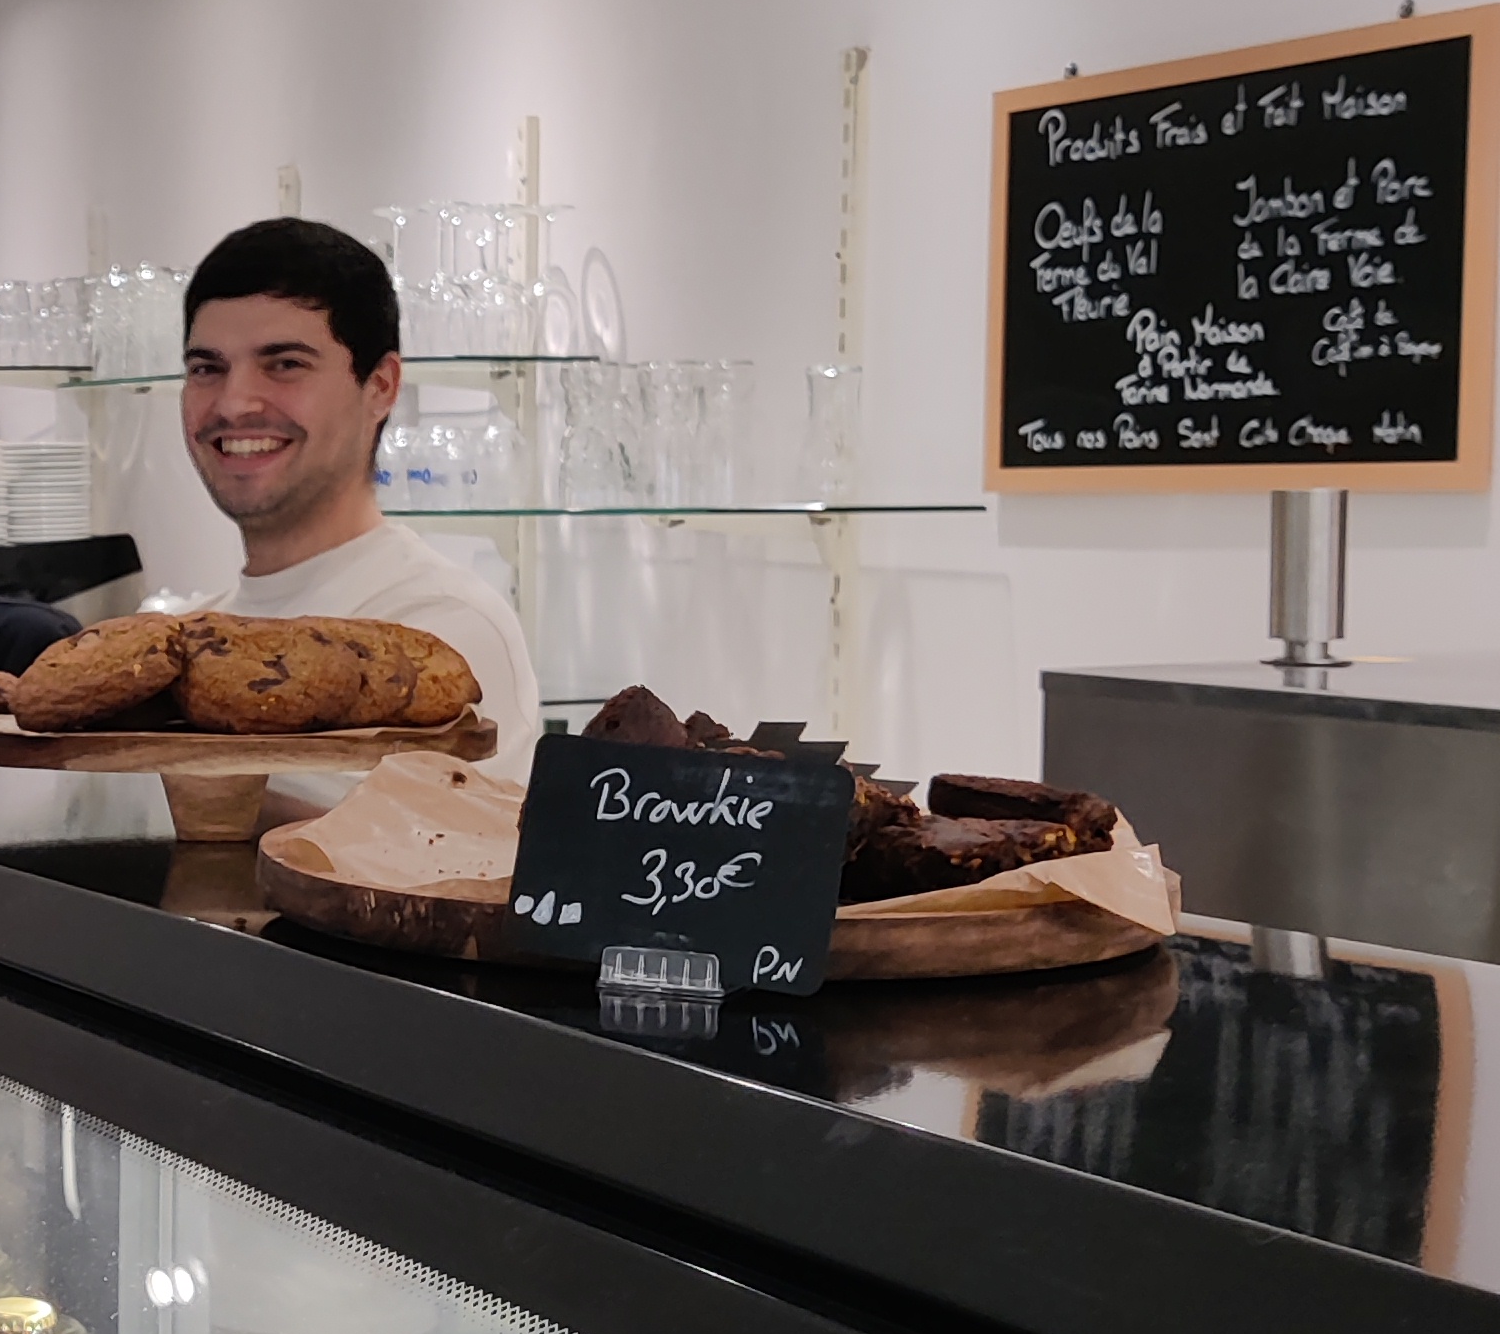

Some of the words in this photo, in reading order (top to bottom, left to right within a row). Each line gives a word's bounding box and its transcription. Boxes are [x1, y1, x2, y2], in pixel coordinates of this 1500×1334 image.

[1038, 108, 1141, 167] Produits
[1149, 101, 1208, 149] Frais
[1221, 83, 1248, 135] et
[1322, 74, 1407, 120] Maison
[1034, 196, 1104, 263] Oeufs
[1110, 193, 1138, 237] de
[1142, 189, 1163, 234] la
[1233, 174, 1326, 227] Jambon
[1237, 231, 1263, 260] de
[1277, 225, 1301, 257] la
[1394, 206, 1427, 245] de
[1029, 251, 1092, 293] Ferme
[1126, 238, 1158, 276] Val
[1237, 262, 1259, 300] la
[1127, 307, 1182, 354] Pain
[1191, 302, 1265, 347] Maison
[1018, 418, 1065, 453] Tous
[1076, 429, 1107, 450] nos
[620, 848, 763, 916] 3,30€
